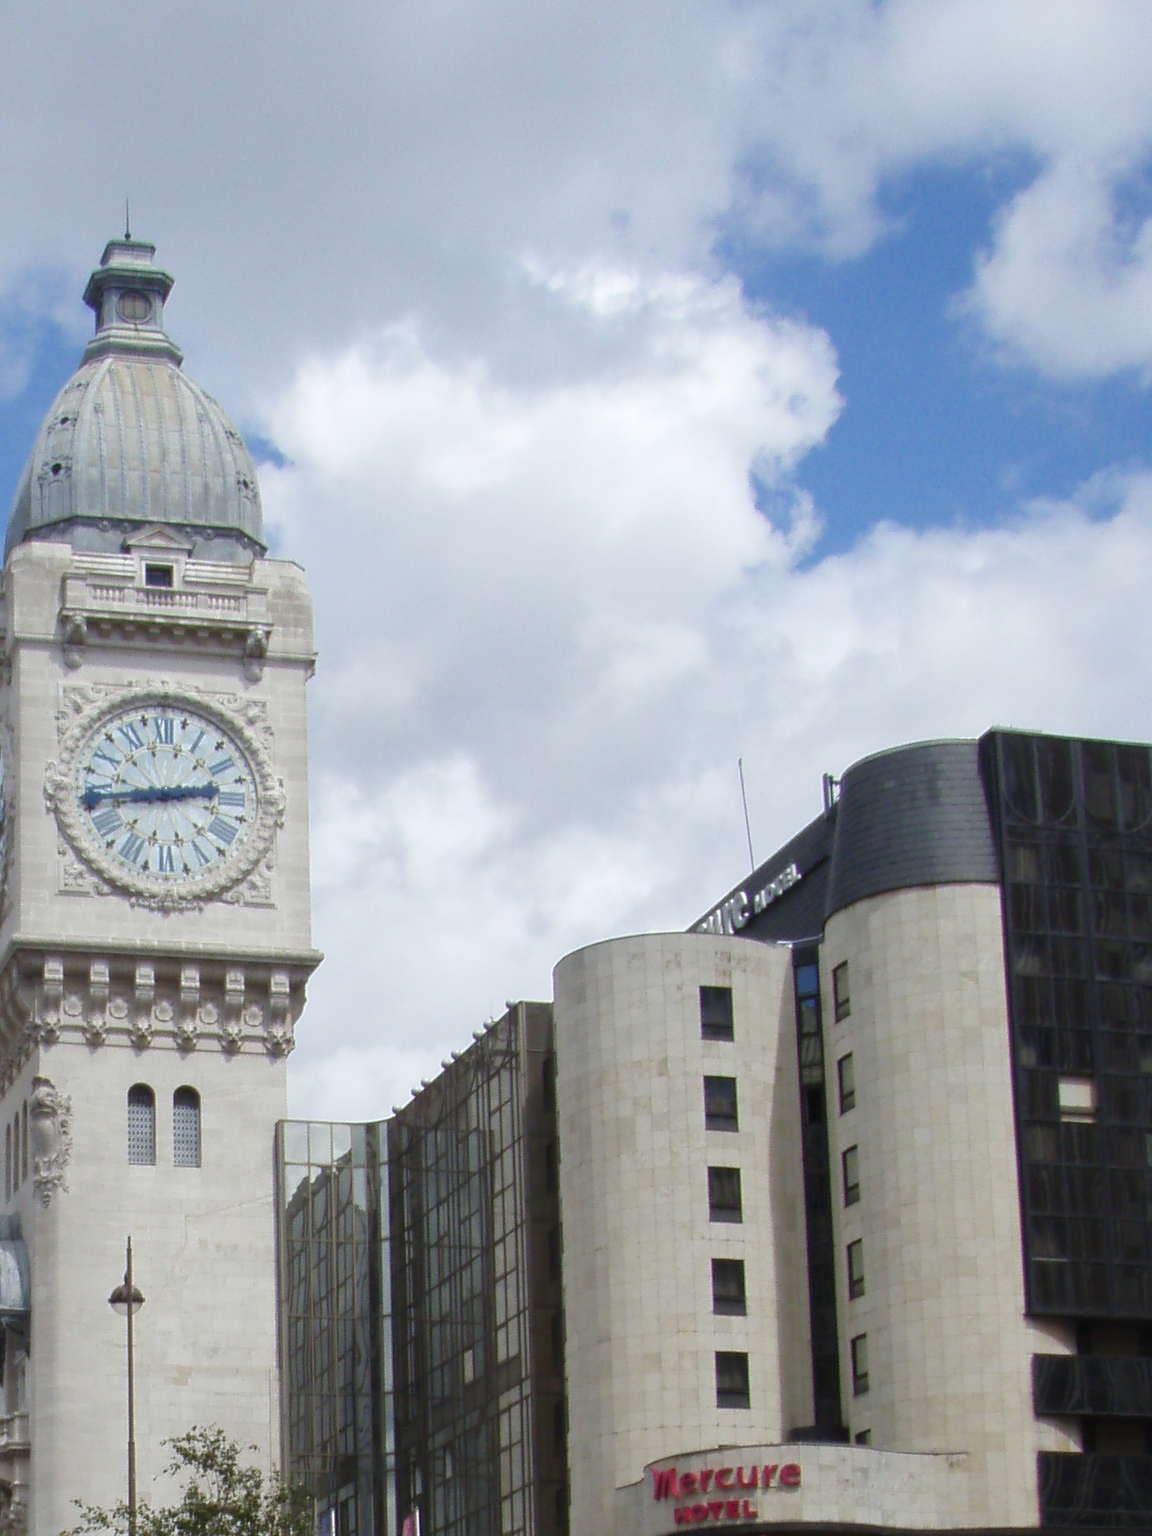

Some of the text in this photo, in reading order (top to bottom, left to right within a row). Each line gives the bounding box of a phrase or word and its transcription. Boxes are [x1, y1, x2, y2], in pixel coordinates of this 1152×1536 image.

[754, 863, 802, 914] HOTEL
[651, 1463, 801, 1501] Mercure
[674, 1500, 758, 1525] HOTEL
